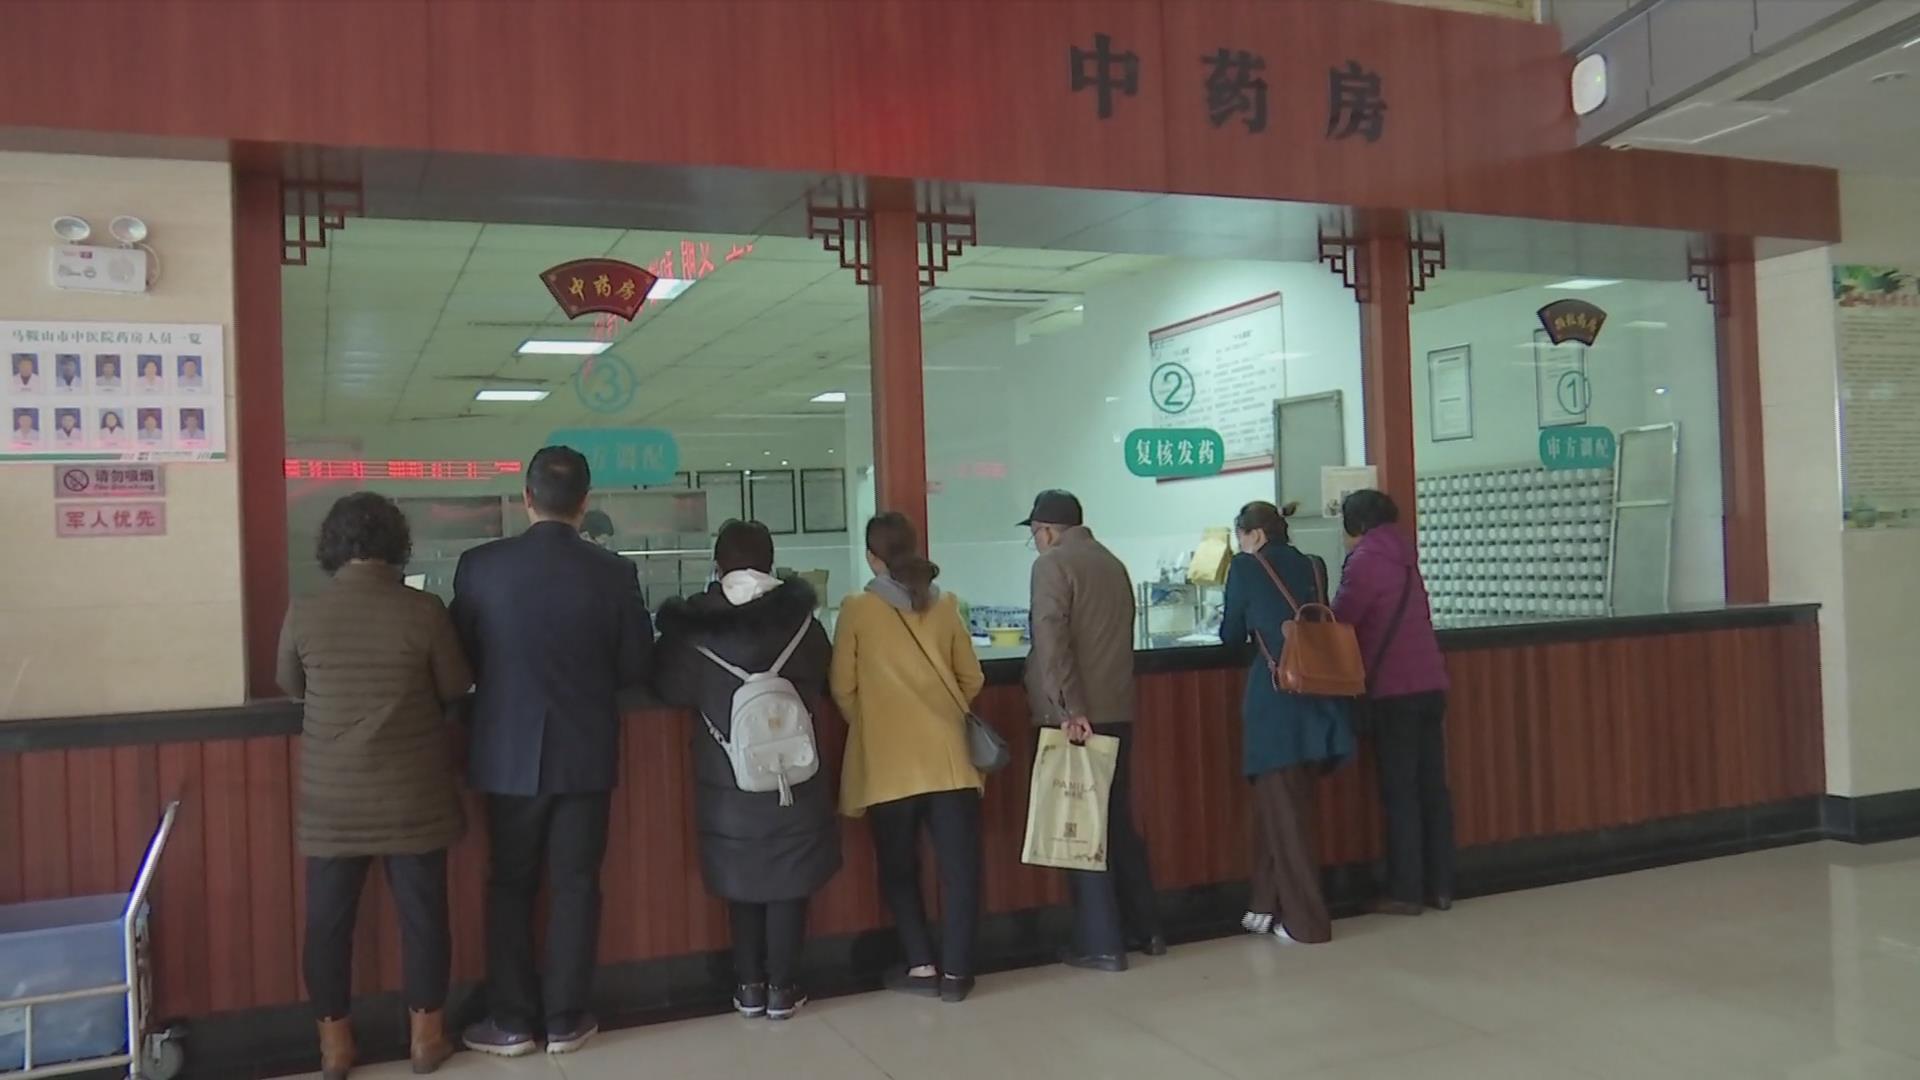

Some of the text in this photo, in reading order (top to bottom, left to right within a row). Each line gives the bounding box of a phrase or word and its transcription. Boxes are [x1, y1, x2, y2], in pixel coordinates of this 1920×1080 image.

[1069, 32, 1388, 143] 中药房
[568, 272, 636, 301] 中药房
[12, 329, 203, 345] 马鞍山市中医院药房人员一览
[1136, 439, 1215, 466] 复核发药
[1546, 436, 1609, 460] 审方调配
[95, 469, 154, 482] 请勿吸烟
[66, 509, 156, 528] 军人优先
